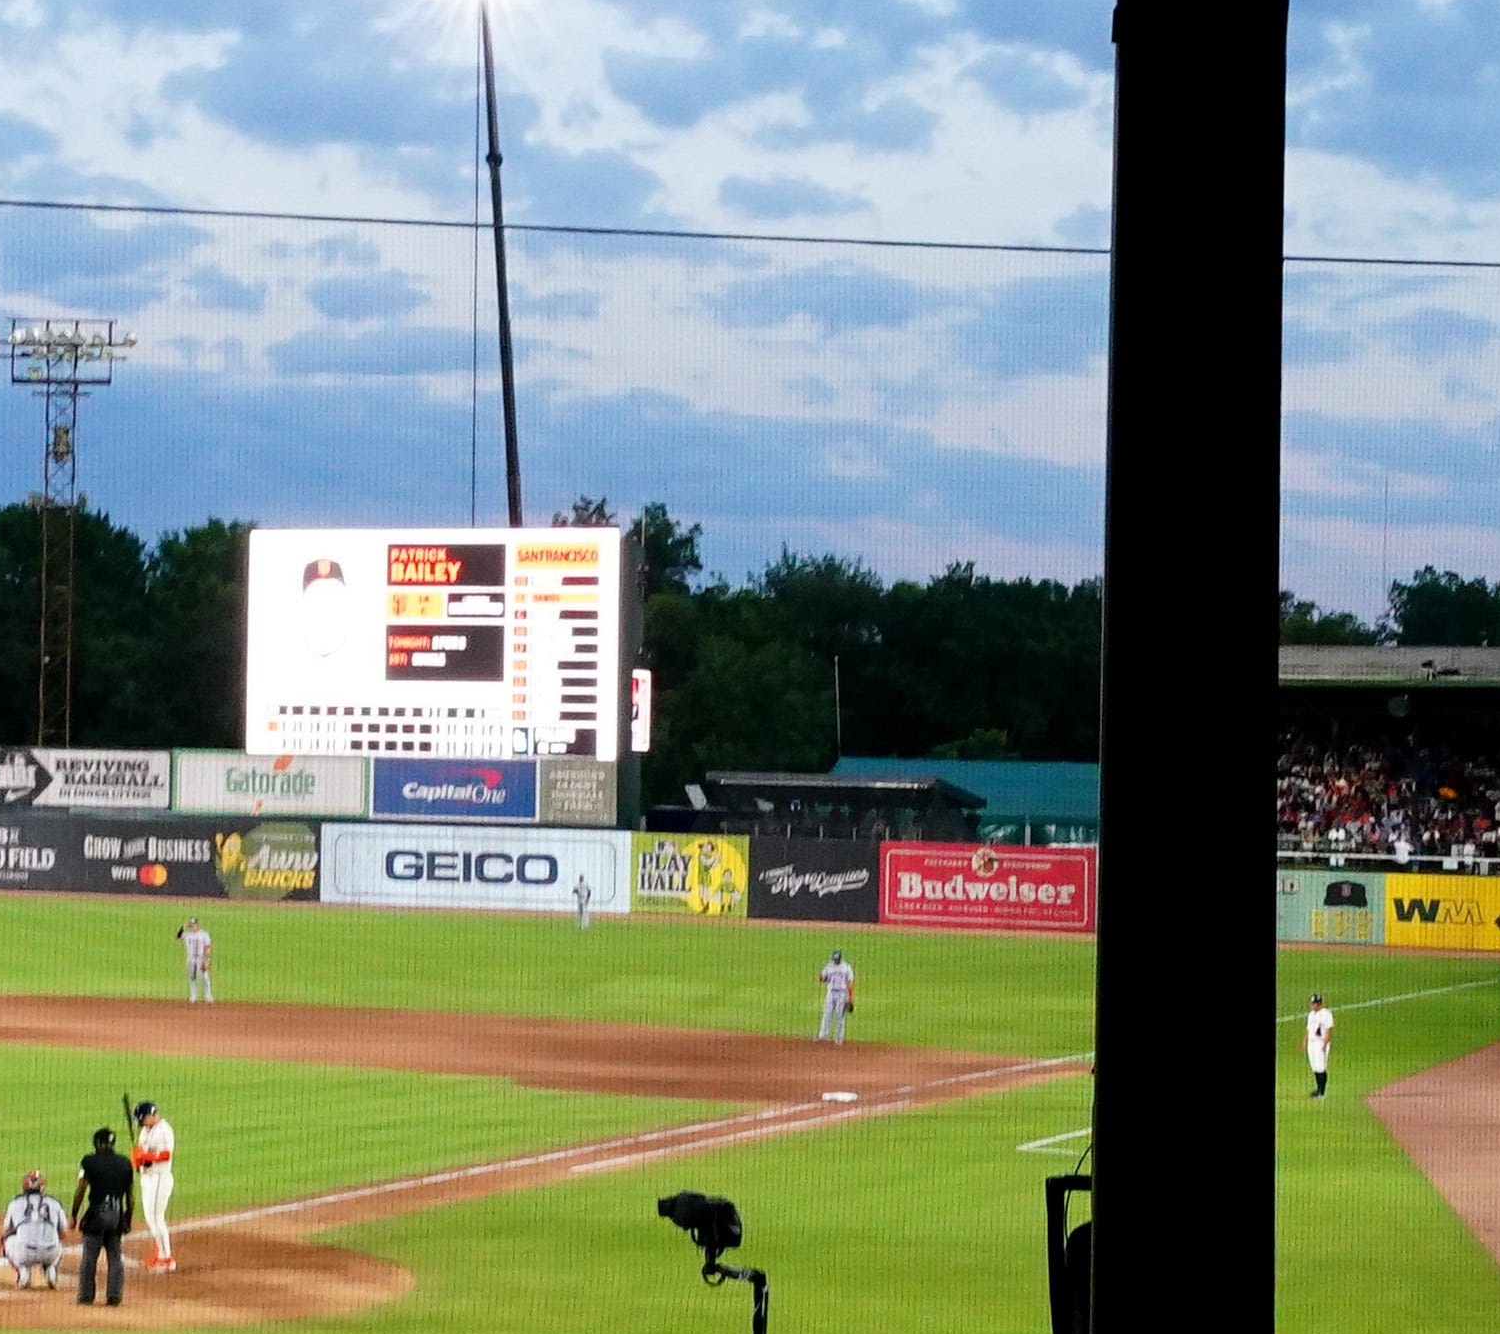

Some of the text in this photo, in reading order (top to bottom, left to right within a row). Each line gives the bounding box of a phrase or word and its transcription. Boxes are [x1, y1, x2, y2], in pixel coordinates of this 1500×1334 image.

[390, 547, 447, 563] PATRICK
[517, 549, 599, 564] SAN FRANCISCO
[390, 561, 462, 582] BAILEY
[55, 757, 150, 774] REVIVING
[63, 772, 165, 789] BASEBALL
[225, 767, 315, 796] Gatorade
[9, 846, 56, 871] FIELD
[84, 834, 122, 860] GROW
[148, 836, 211, 863] BUSINESS
[384, 849, 559, 885] GEICO
[641, 851, 693, 871] PLAY
[639, 870, 693, 893] BALL
[811, 868, 870, 898] Leagues
[896, 871, 1077, 905] Budweiser
[1393, 896, 1486, 925] WM
